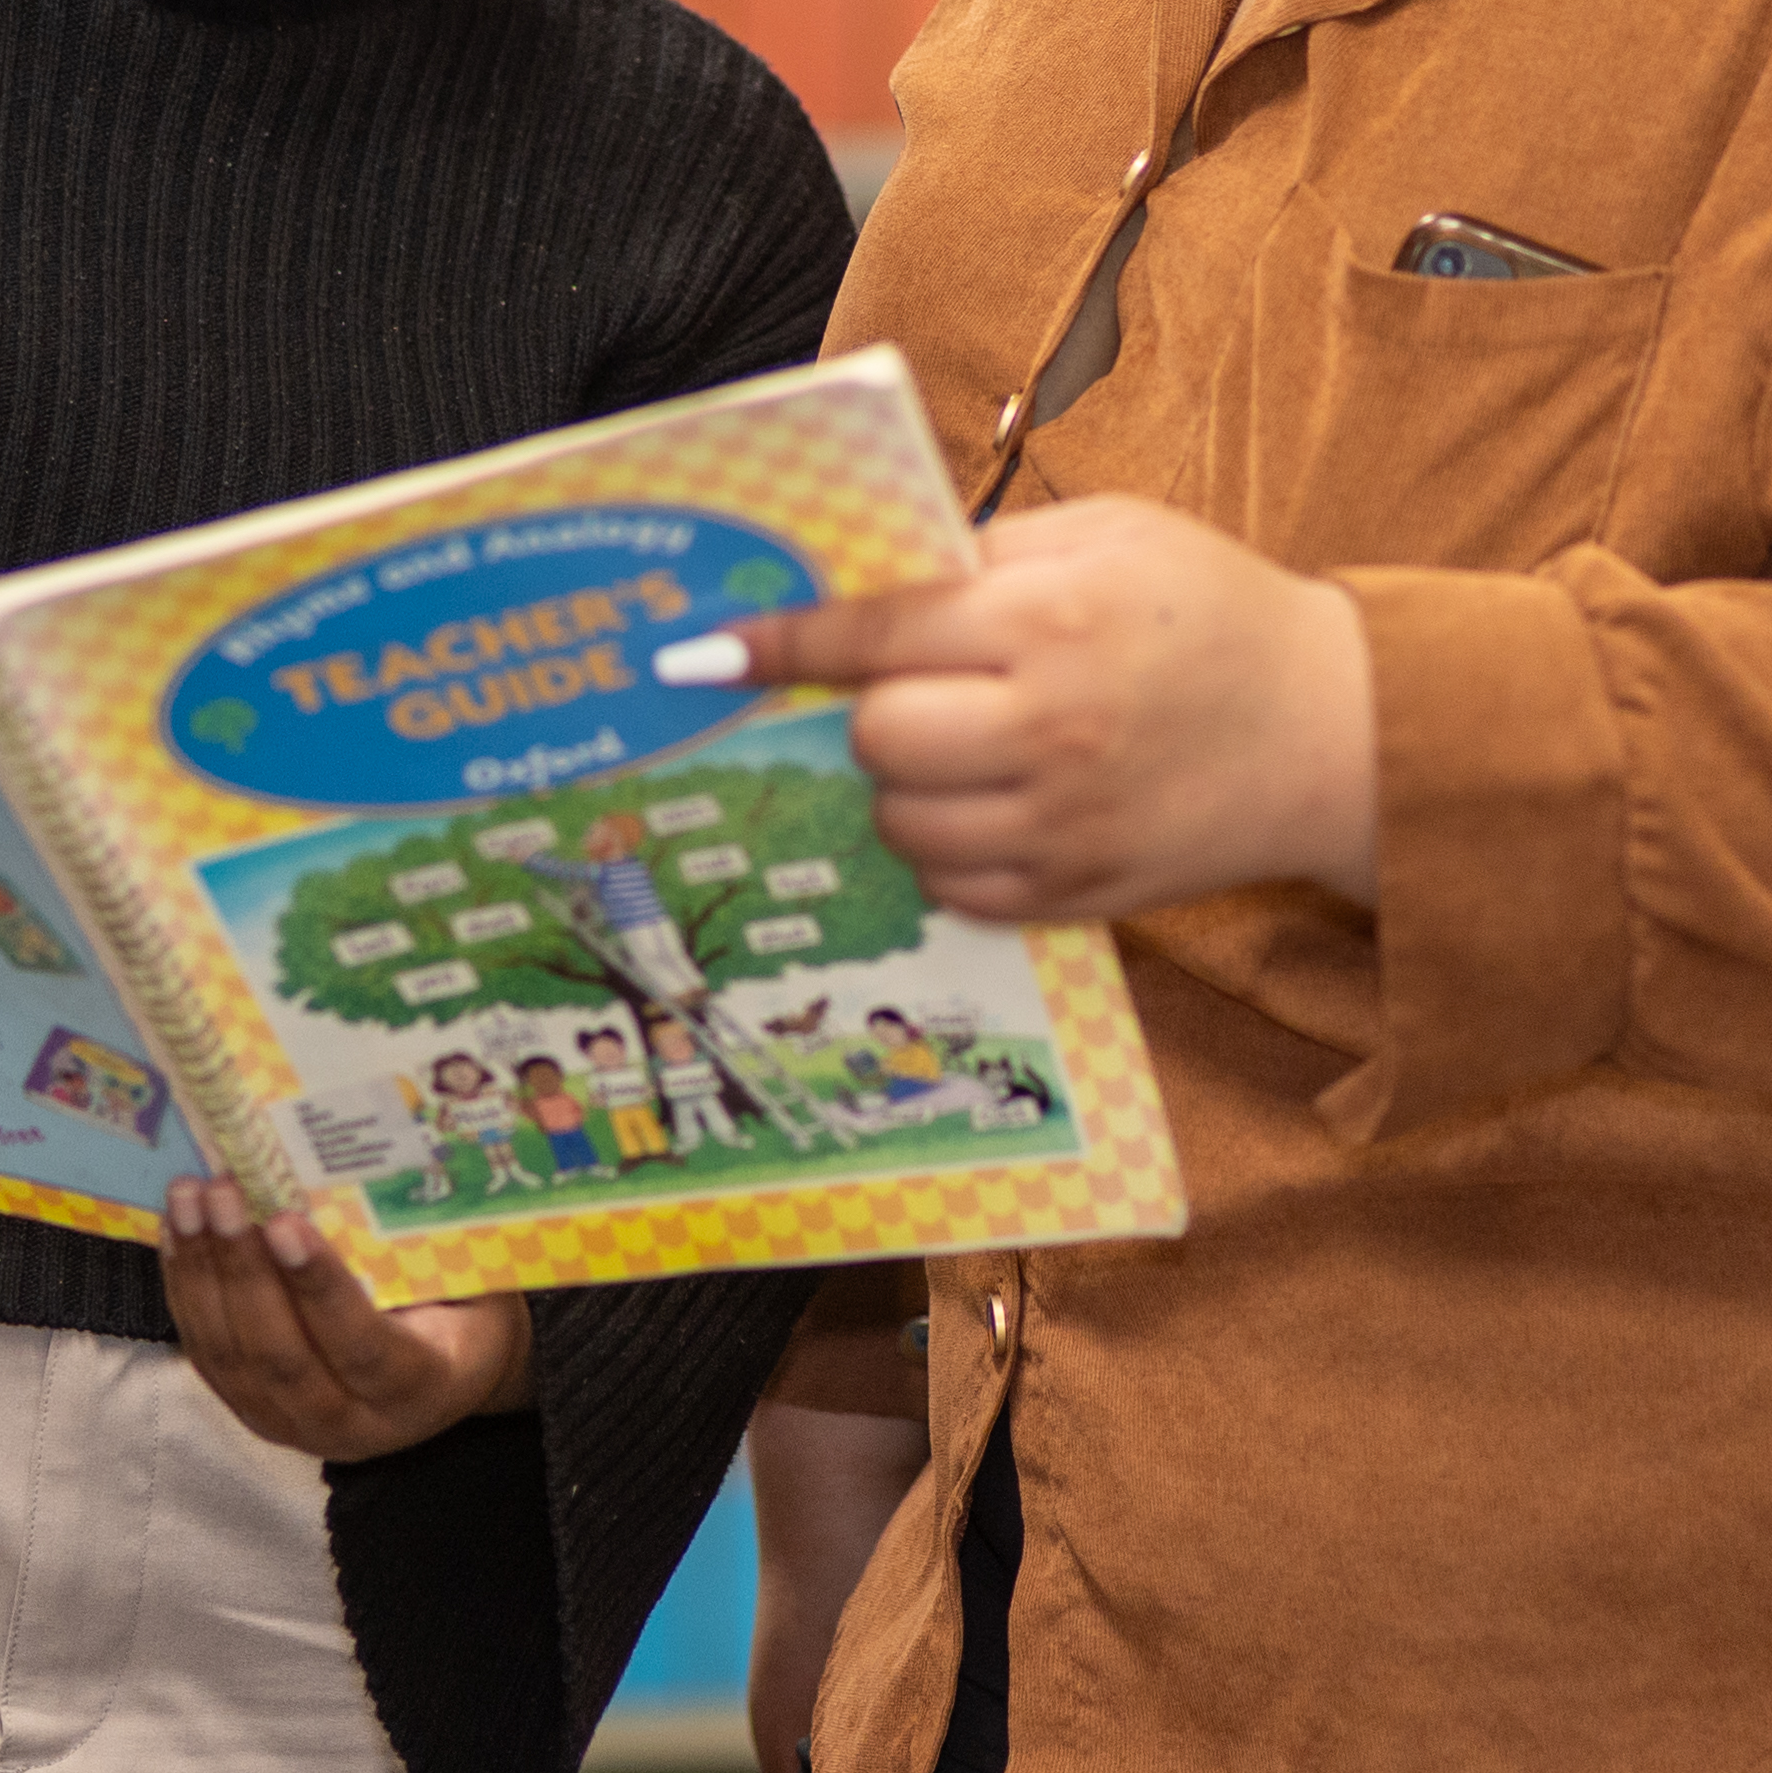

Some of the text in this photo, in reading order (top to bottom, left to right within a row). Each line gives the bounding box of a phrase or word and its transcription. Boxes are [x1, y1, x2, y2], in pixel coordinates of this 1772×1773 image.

[378, 540, 474, 591] and
[482, 512, 696, 563] Analogy
[271, 570, 691, 715] TEACHER'S
[386, 642, 637, 741] GUIDE
[463, 727, 626, 793] Oxford
